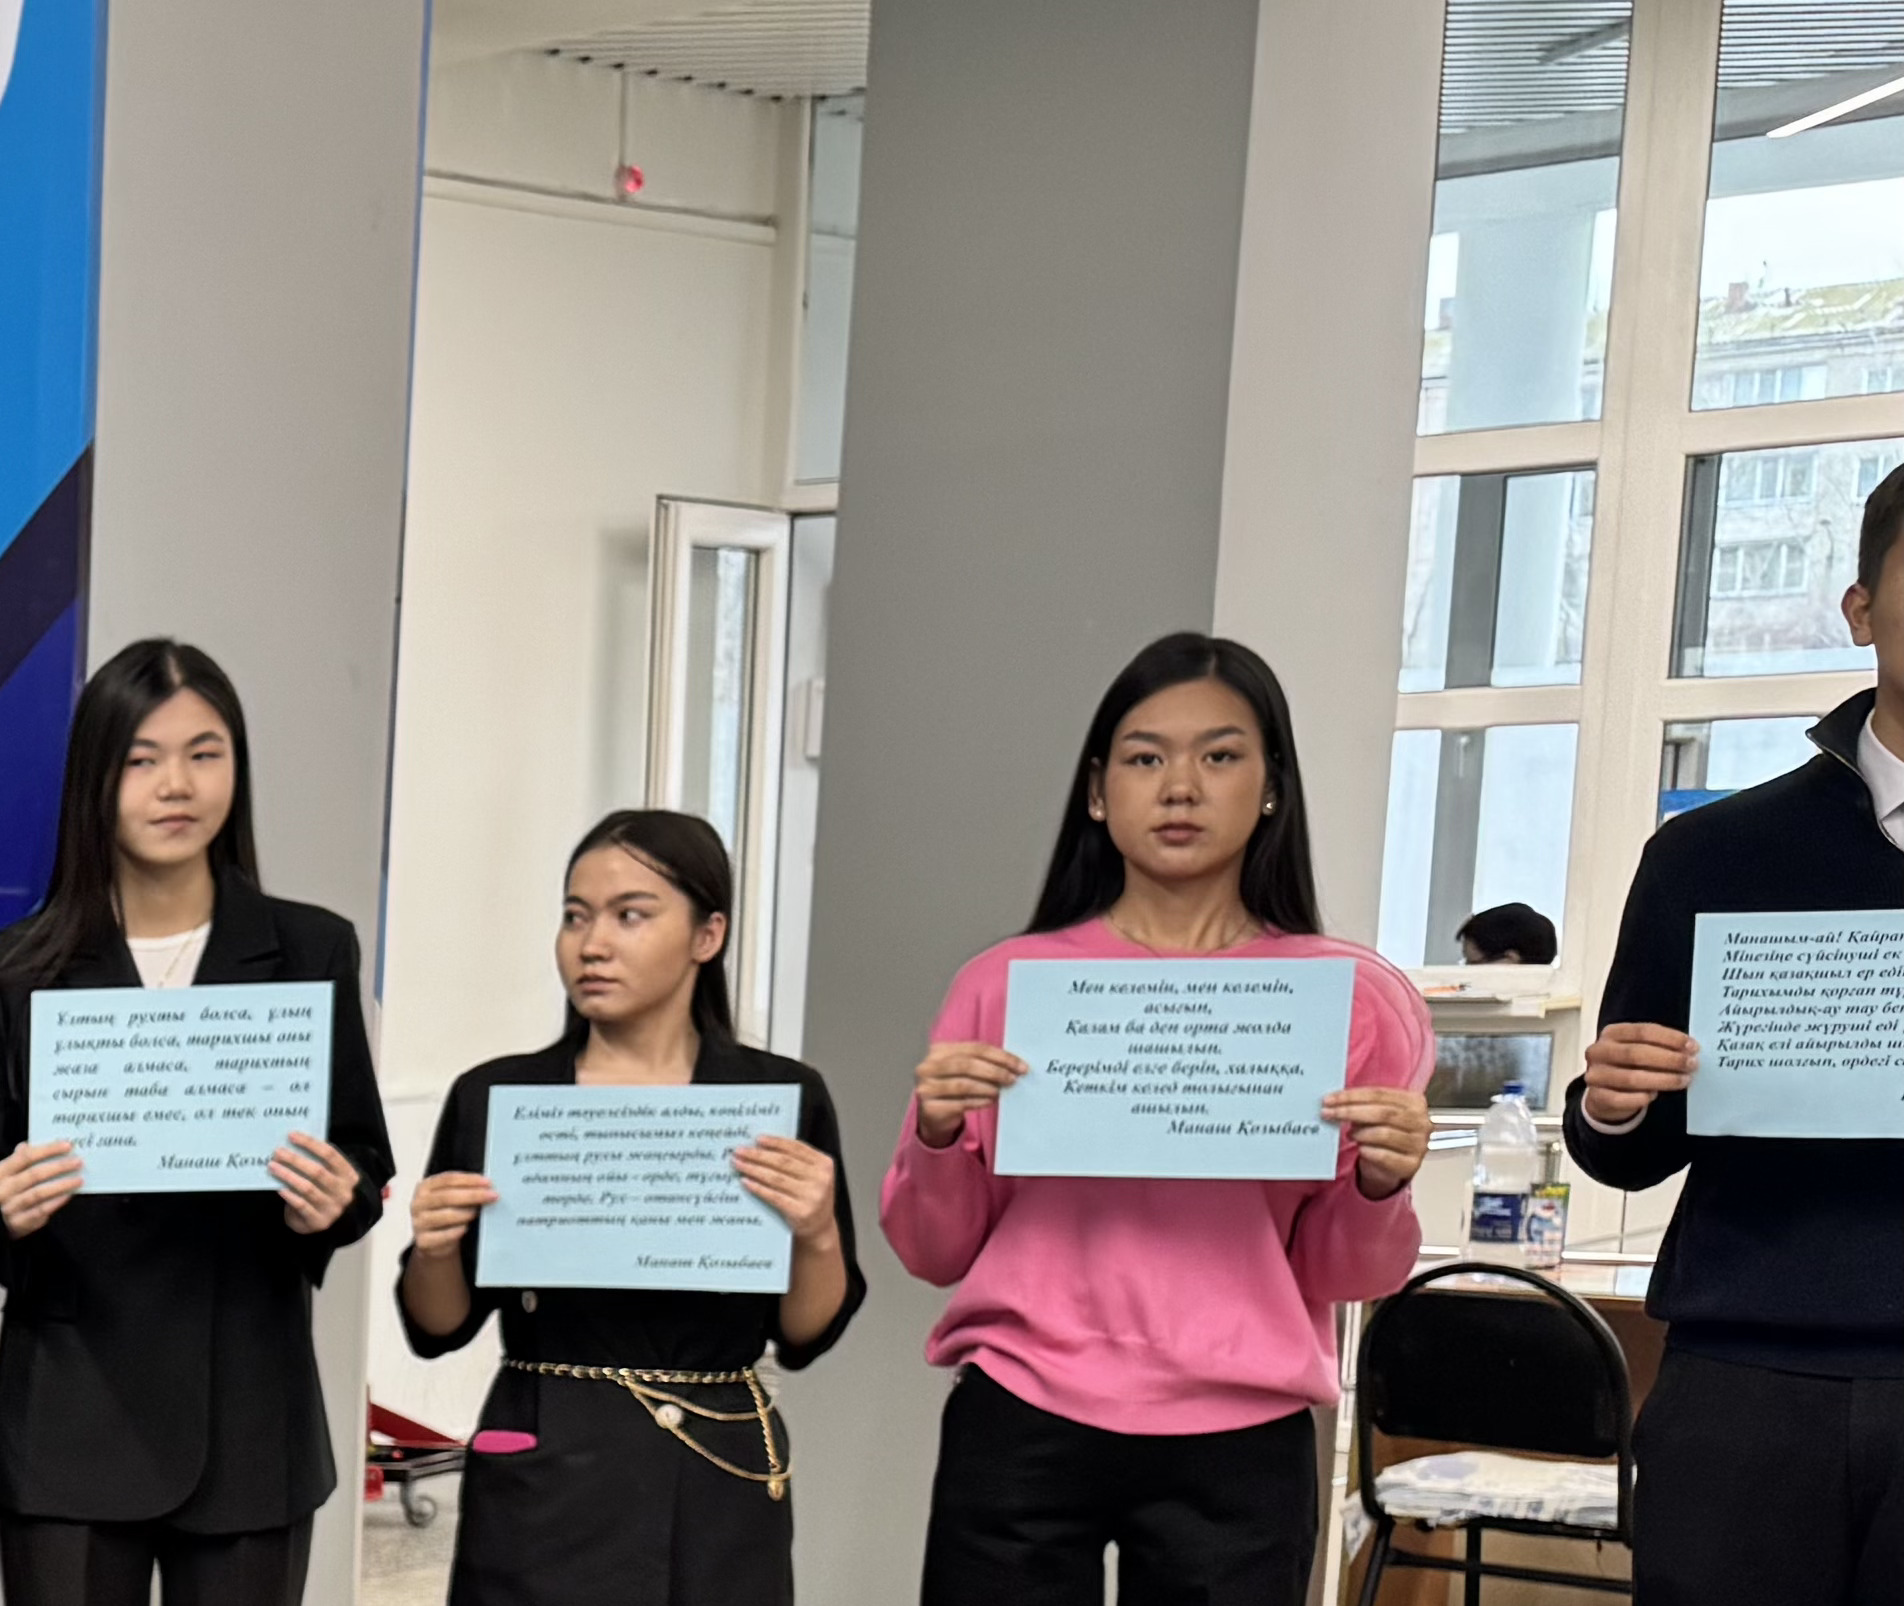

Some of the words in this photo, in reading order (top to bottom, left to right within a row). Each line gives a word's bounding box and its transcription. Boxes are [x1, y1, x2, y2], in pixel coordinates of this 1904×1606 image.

[1721, 966, 1765, 981] Шын
[1856, 967, 1875, 982] ер
[1068, 978, 1105, 995] Мен
[1182, 982, 1217, 995] мен
[1722, 985, 1816, 1001] Тарихымды
[1124, 1018, 1146, 1035] ба
[1717, 1055, 1765, 1071] Тарих
[1166, 1118, 1232, 1136] Манаш
[156, 1152, 222, 1171] Манаш
